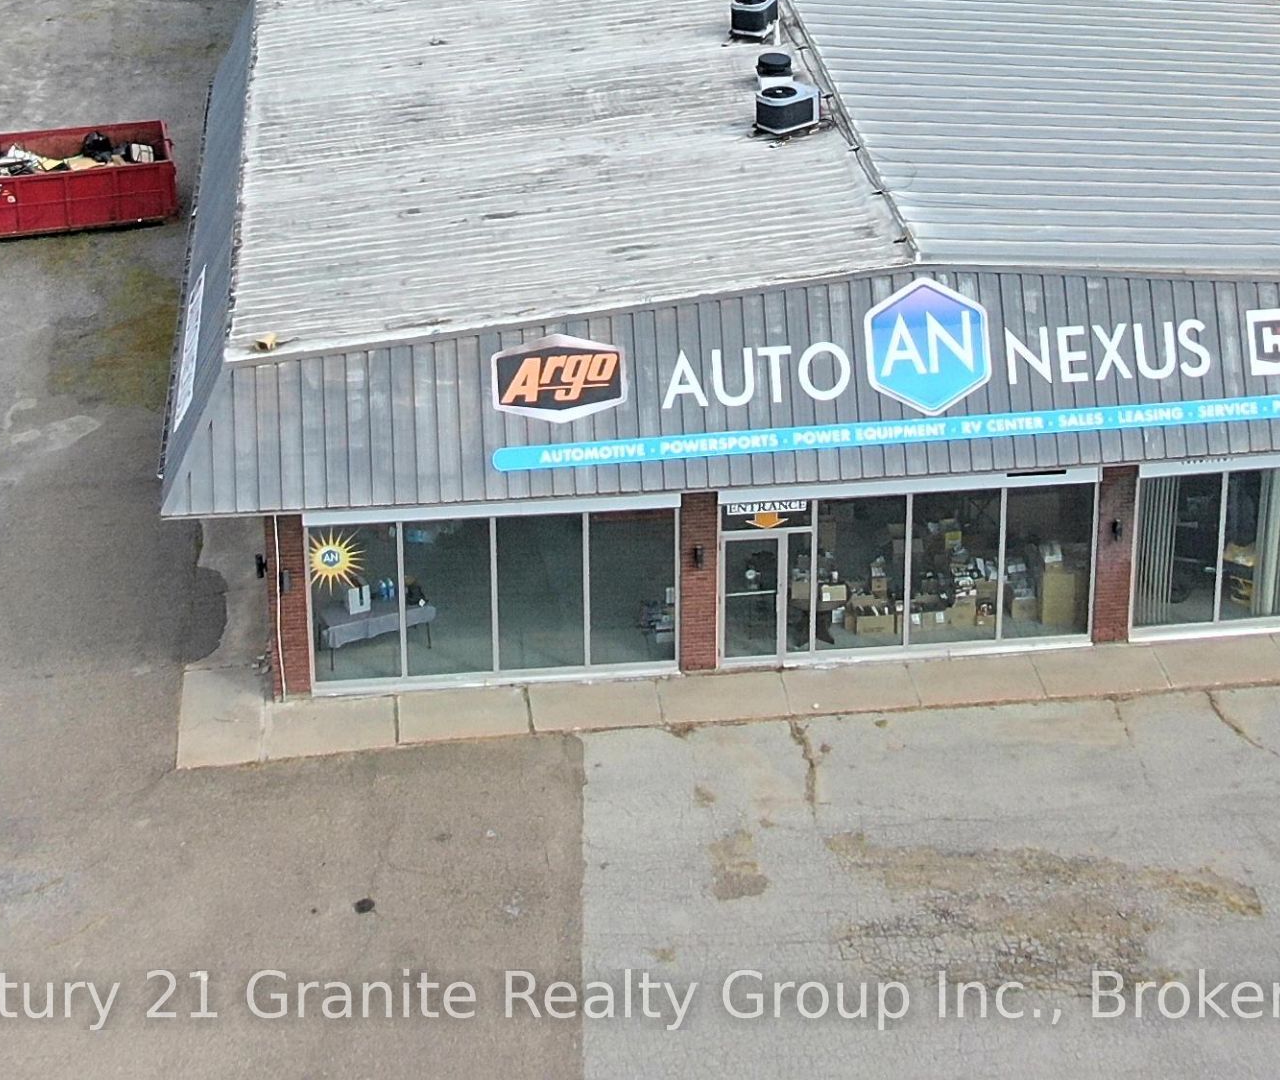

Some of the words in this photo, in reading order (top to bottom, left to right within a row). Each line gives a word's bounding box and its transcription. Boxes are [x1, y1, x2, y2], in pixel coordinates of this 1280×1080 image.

[501, 353, 618, 404] Argo
[661, 340, 851, 409] AUTO
[880, 310, 974, 377] AN
[1004, 318, 1211, 386] NEXUS
[539, 443, 645, 464] AUTOMOTIVE
[660, 433, 779, 454] POWERSPORTS
[793, 428, 851, 445] POWER
[855, 422, 946, 441] EQUIPMENT
[961, 420, 981, 434] RV
[986, 416, 1044, 432] CENTER
[1057, 411, 1104, 427] SALES
[1118, 406, 1183, 424] LEASING
[1197, 401, 1259, 419] SERVICE
[729, 500, 807, 513] ENTRANCE
[323, 552, 338, 562] AN
